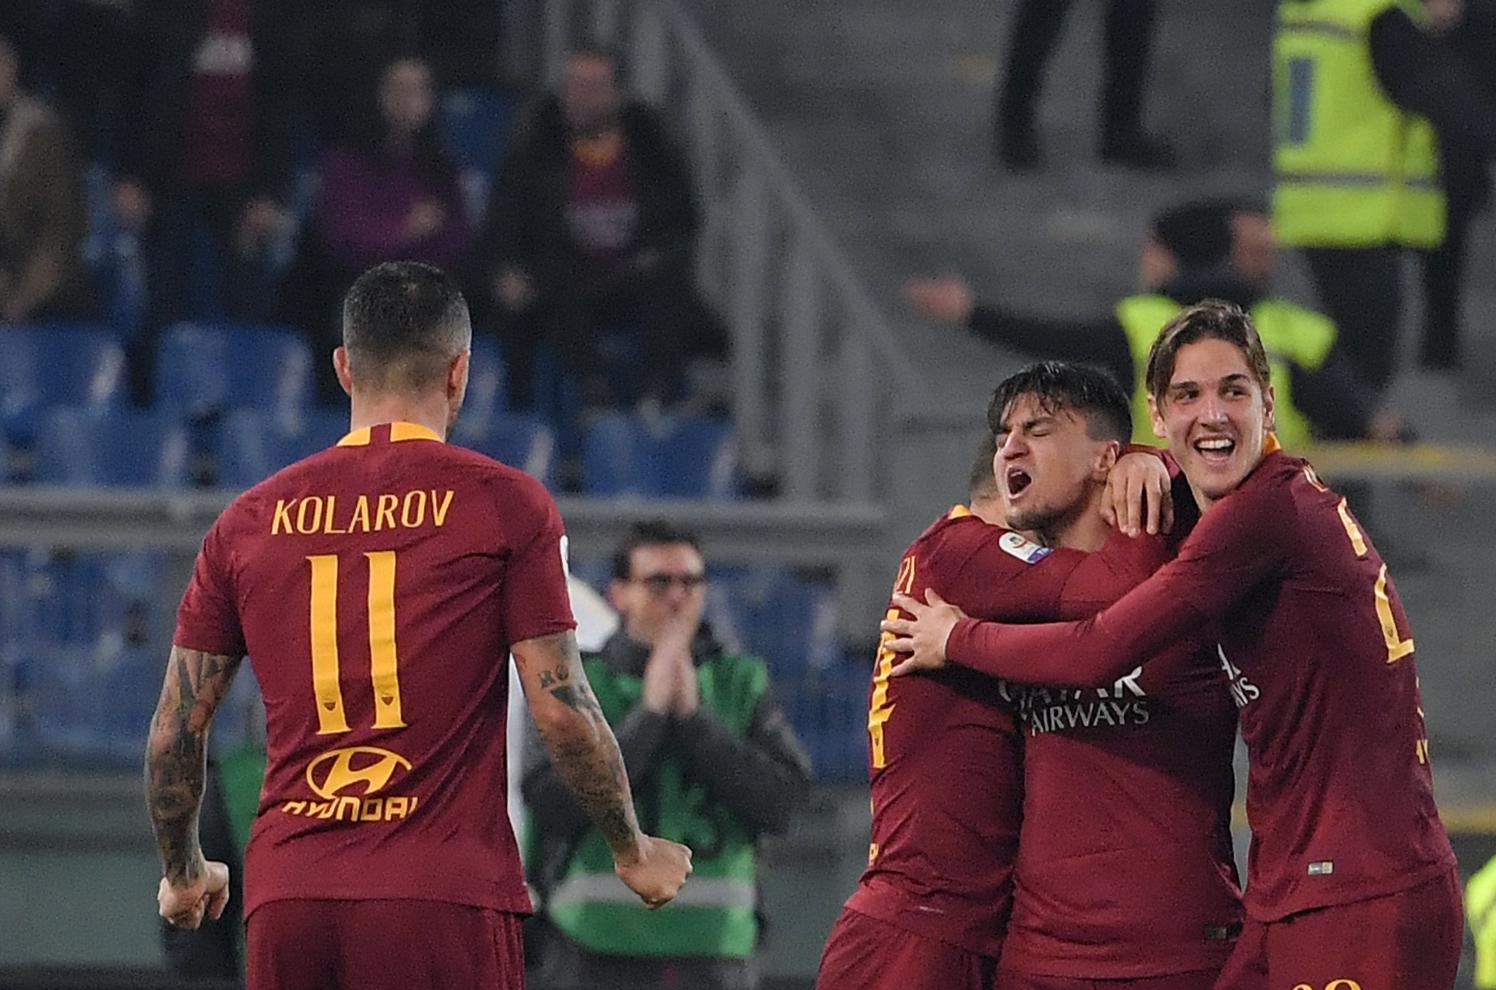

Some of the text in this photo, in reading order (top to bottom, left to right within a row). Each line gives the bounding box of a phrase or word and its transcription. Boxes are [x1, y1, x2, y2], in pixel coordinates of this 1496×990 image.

[271, 489, 455, 535] KOLAROV
[305, 550, 408, 735] 11
[1031, 699, 1149, 737] AIRWAYS
[281, 796, 418, 822] HYUNDAI
